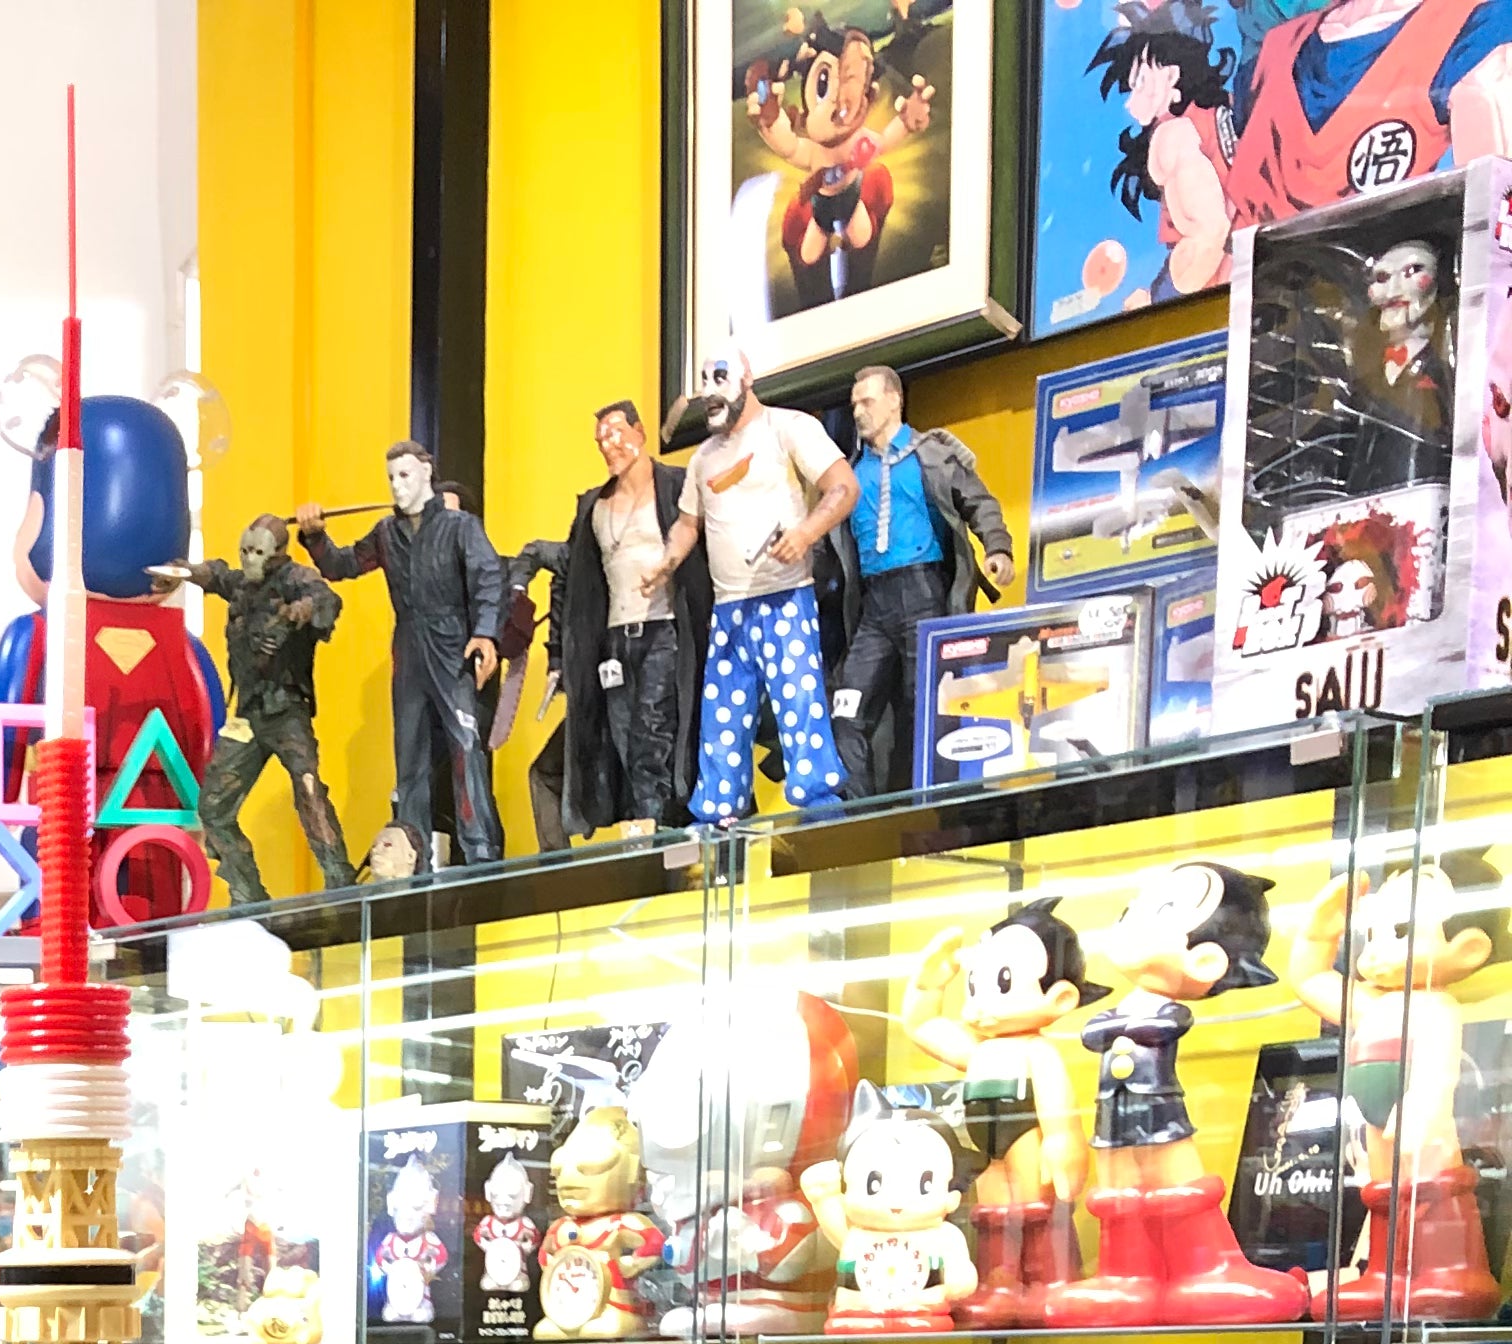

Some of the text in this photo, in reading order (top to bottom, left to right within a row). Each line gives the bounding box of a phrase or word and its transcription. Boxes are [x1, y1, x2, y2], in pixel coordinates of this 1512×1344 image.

[1354, 127, 1410, 187] 悟
[1295, 647, 1384, 719] SAW
[1254, 1171, 1283, 1196] Uh
